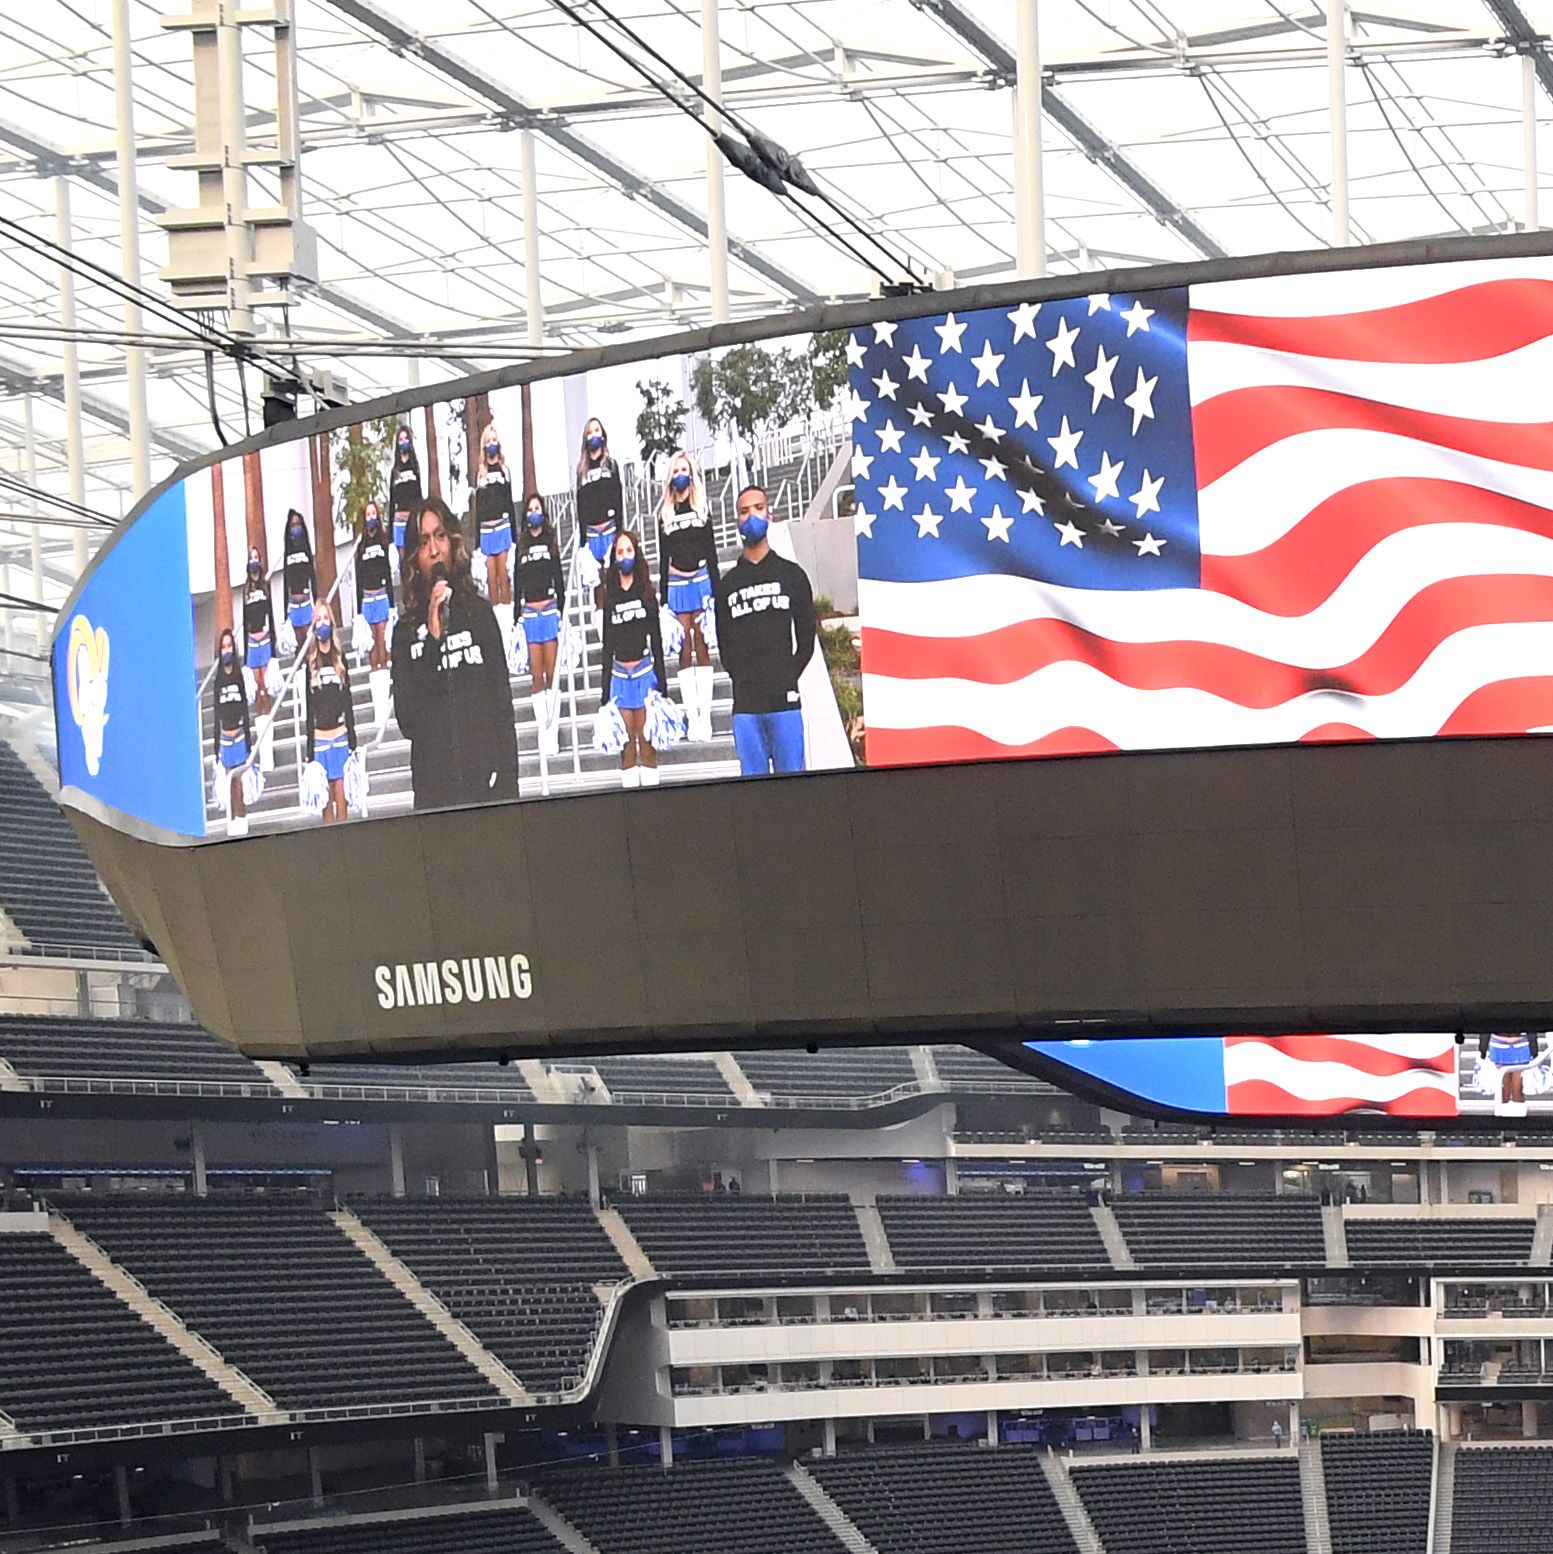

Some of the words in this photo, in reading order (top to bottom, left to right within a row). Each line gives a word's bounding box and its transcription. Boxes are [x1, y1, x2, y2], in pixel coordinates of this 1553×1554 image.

[745, 582, 782, 602] TAKES
[755, 598, 772, 614] OF
[374, 953, 533, 1010] SAMSUNG
